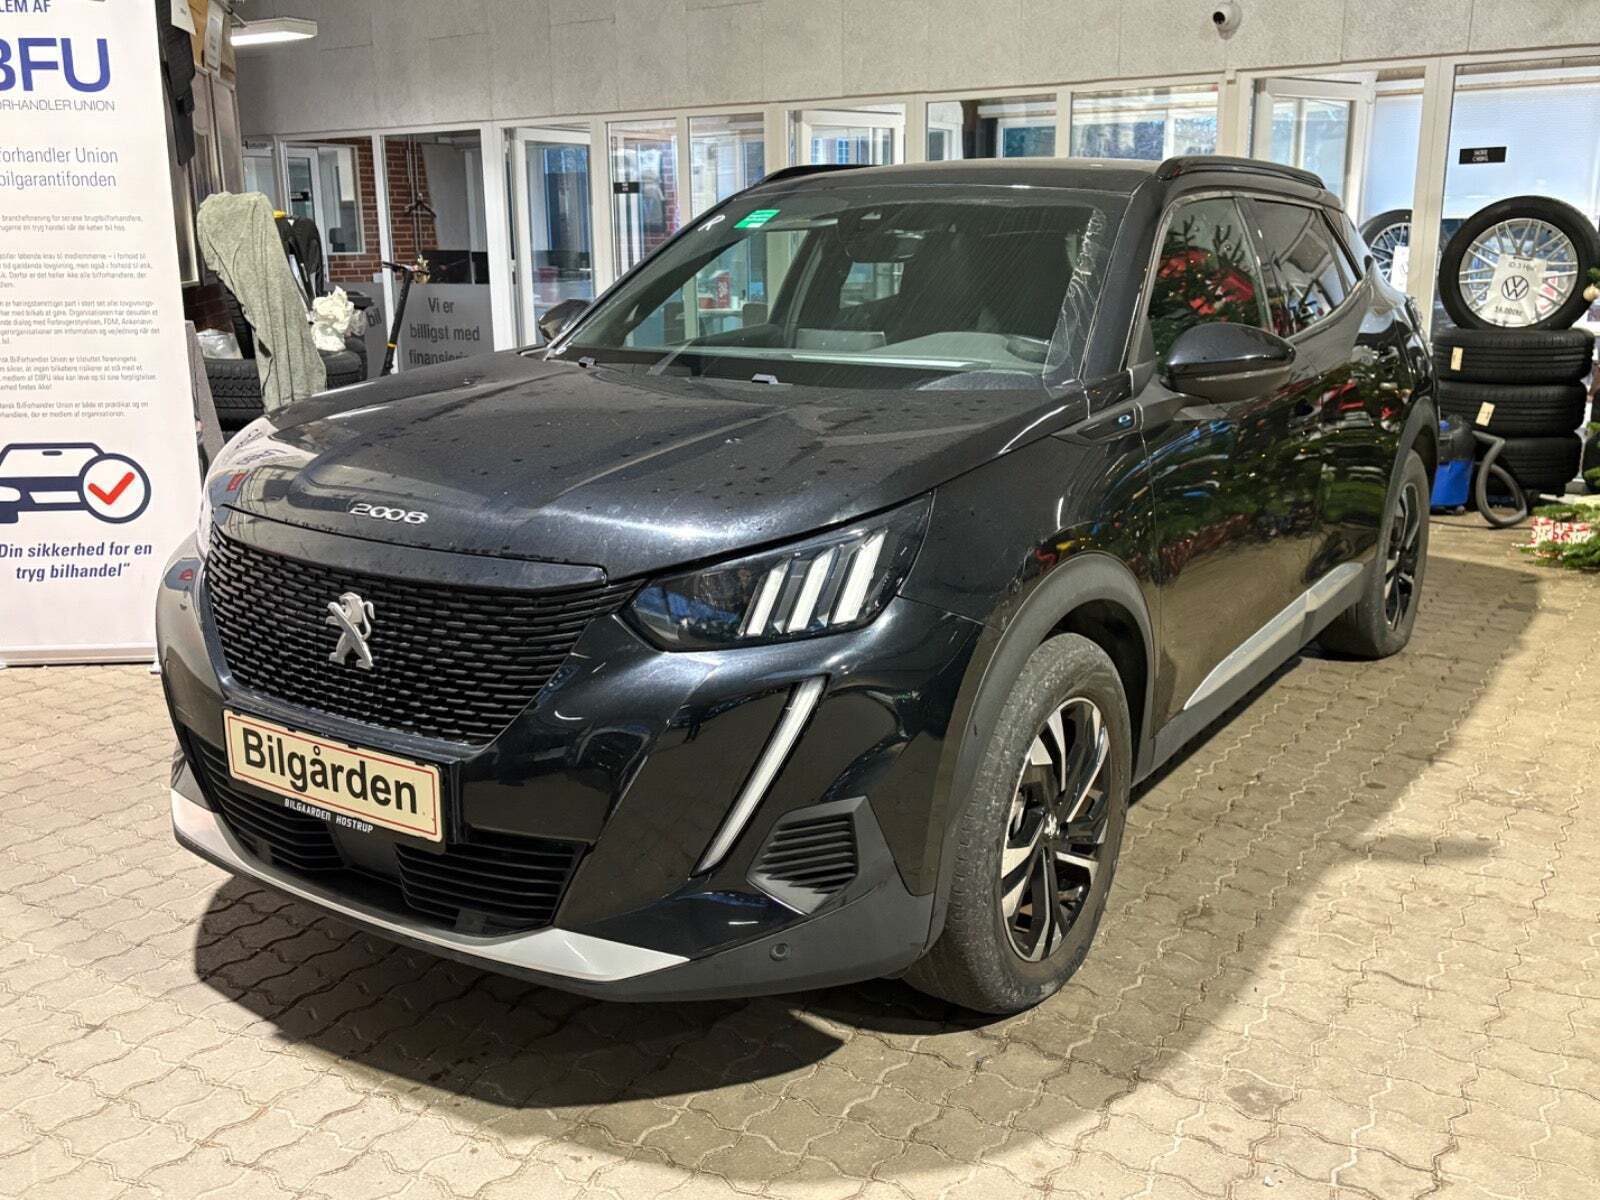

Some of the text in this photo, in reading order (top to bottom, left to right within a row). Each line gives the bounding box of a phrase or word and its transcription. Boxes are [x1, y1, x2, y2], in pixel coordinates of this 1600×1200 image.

[33, 0, 51, 13] AF
[0, 99, 116, 112] RHANDLER UNION
[75, 146, 119, 163] Union
[427, 297, 455, 313] Vi er
[409, 323, 480, 344] billigst med
[348, 502, 430, 525] 2008
[27, 542, 105, 559] sikkerhed
[109, 541, 131, 556] for
[134, 543, 153, 556] en
[16, 567, 46, 583] tryg
[242, 727, 418, 815] Bilgården
[284, 798, 374, 834] BILGAARDEN HOSTRUP
